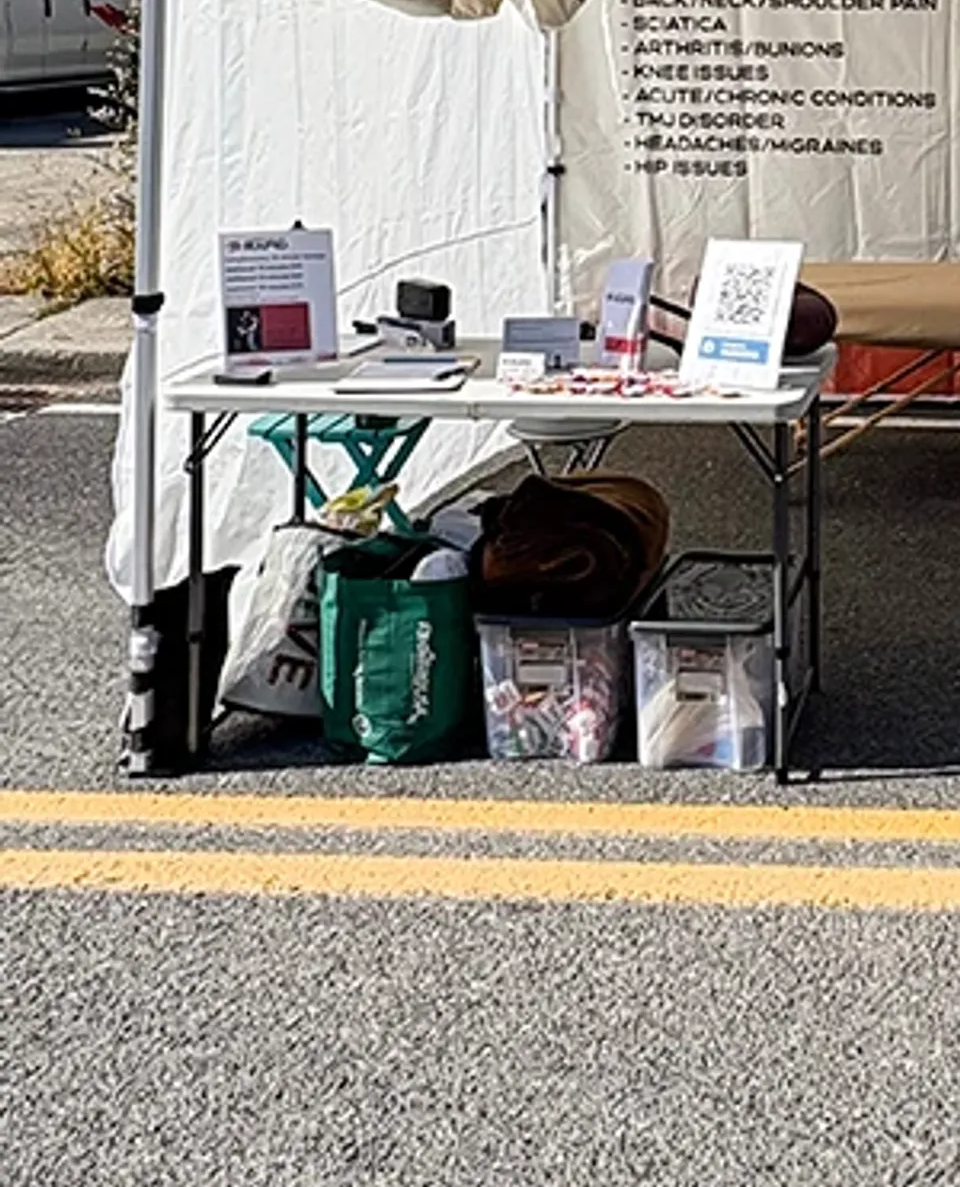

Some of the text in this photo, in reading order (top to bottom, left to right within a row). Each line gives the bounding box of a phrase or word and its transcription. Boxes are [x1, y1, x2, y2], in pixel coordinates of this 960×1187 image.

[633, 16, 728, 33] SCIATICA
[633, 64, 770, 81] KNEE ISSUES
[810, 90, 936, 109] CONDITIONS
[636, 112, 785, 130] TMJ DISORDER
[635, 160, 748, 176] HIP ISSUES
